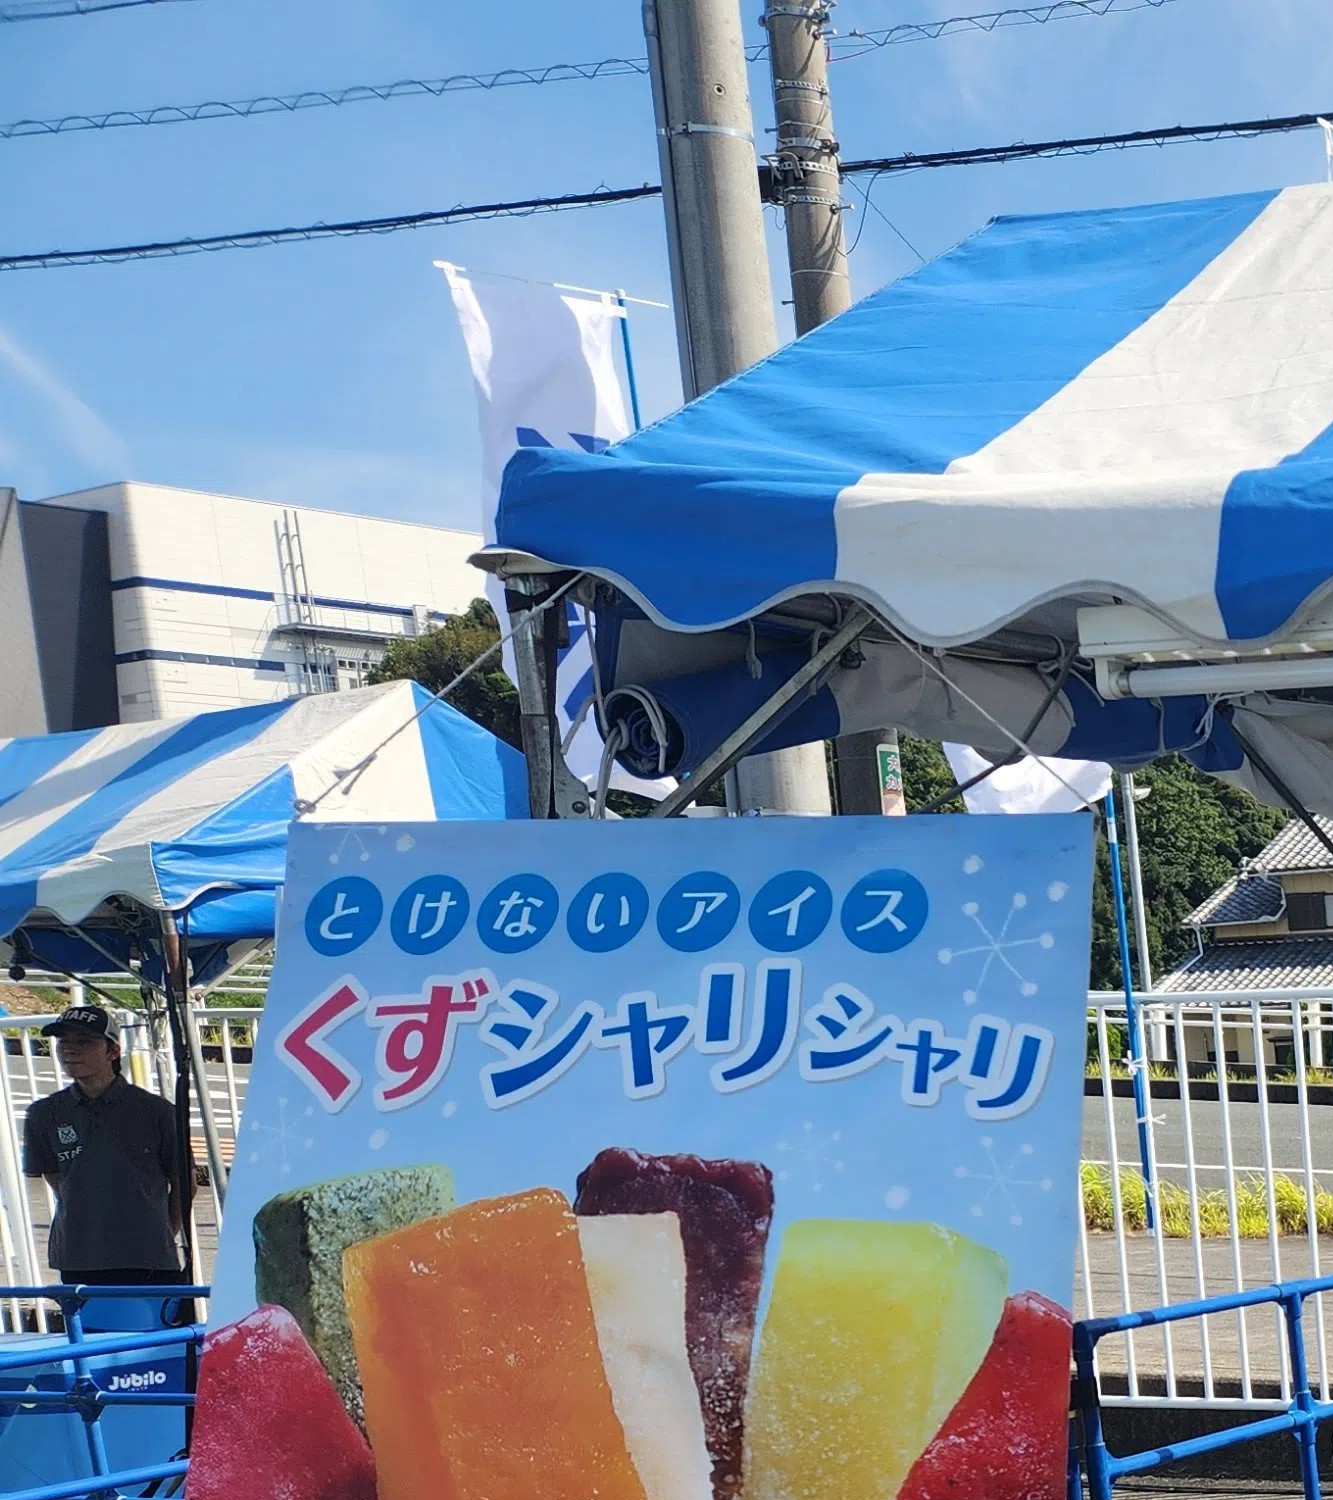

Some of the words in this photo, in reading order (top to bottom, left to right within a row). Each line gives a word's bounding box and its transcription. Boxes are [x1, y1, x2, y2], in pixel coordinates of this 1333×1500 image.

[316, 885, 911, 943] とけないアイス
[282, 966, 1044, 1110] くずシャリシャリ
